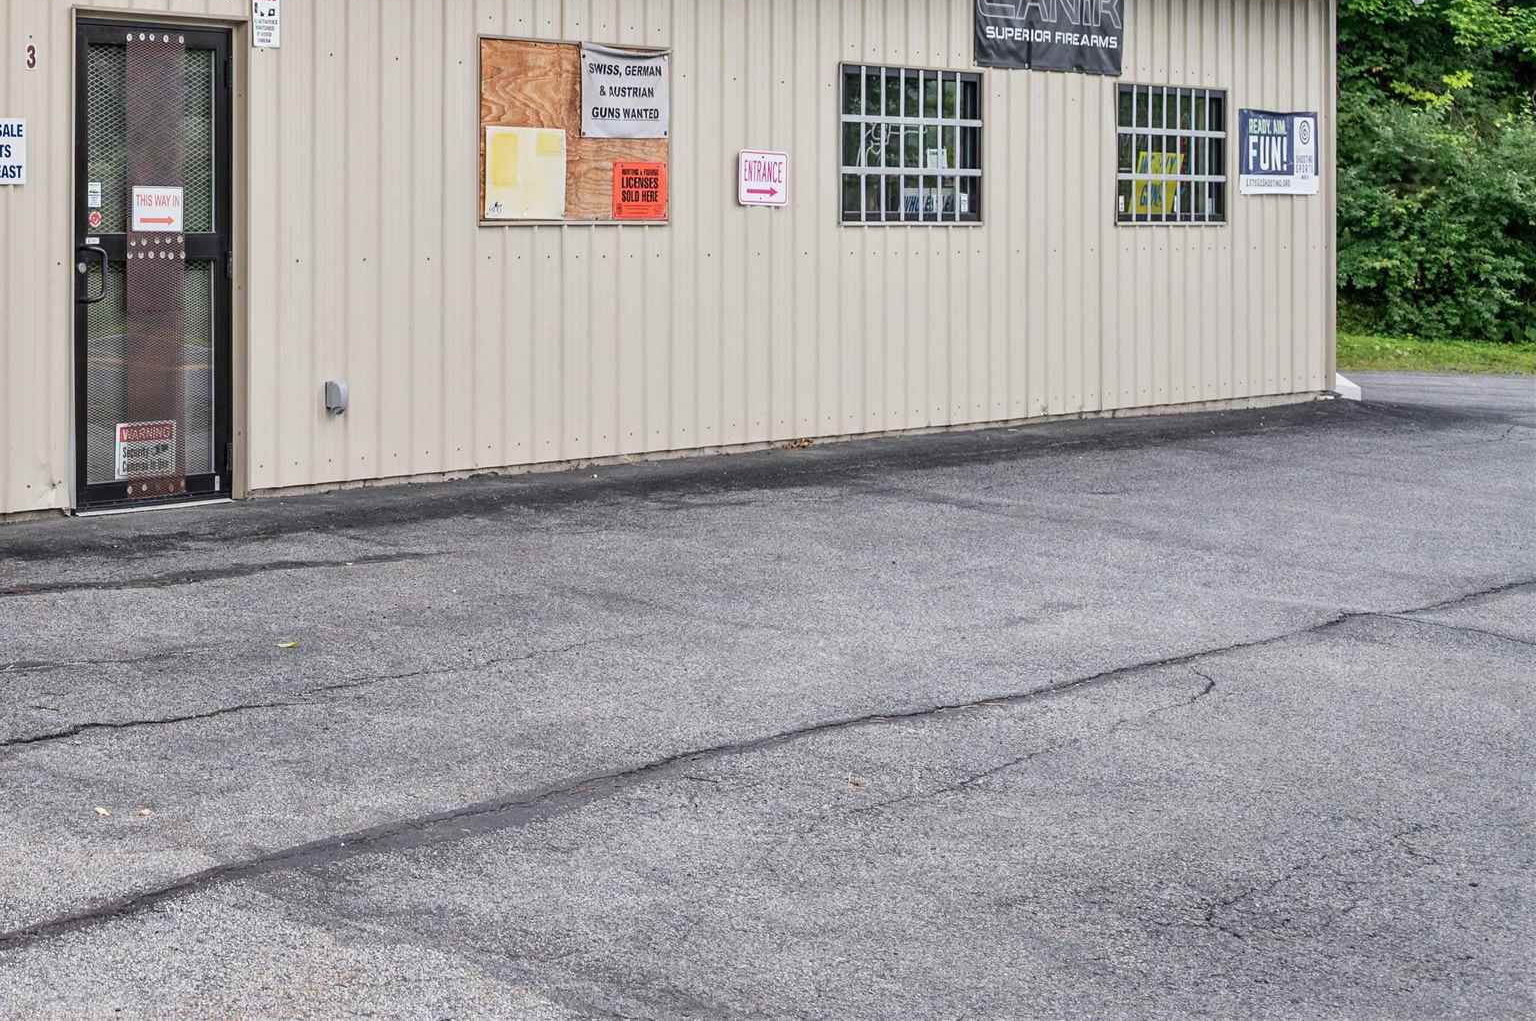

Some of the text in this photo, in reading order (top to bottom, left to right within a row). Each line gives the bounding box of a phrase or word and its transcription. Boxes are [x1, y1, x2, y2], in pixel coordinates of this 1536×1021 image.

[985, 25, 1118, 49] SUPERIOR FIREARMS
[588, 63, 662, 78] SWISS, GERMAN
[599, 85, 655, 98] & AUSTRIAN
[591, 106, 660, 119] GUNS WANTED
[1248, 135, 1288, 171] FUN!
[744, 160, 783, 183] ENTRANCE
[621, 177, 659, 189] LICENSES
[136, 194, 180, 207] THIS WAY IN
[621, 190, 658, 202] SOLD HERE
[120, 425, 170, 440] WARNING
